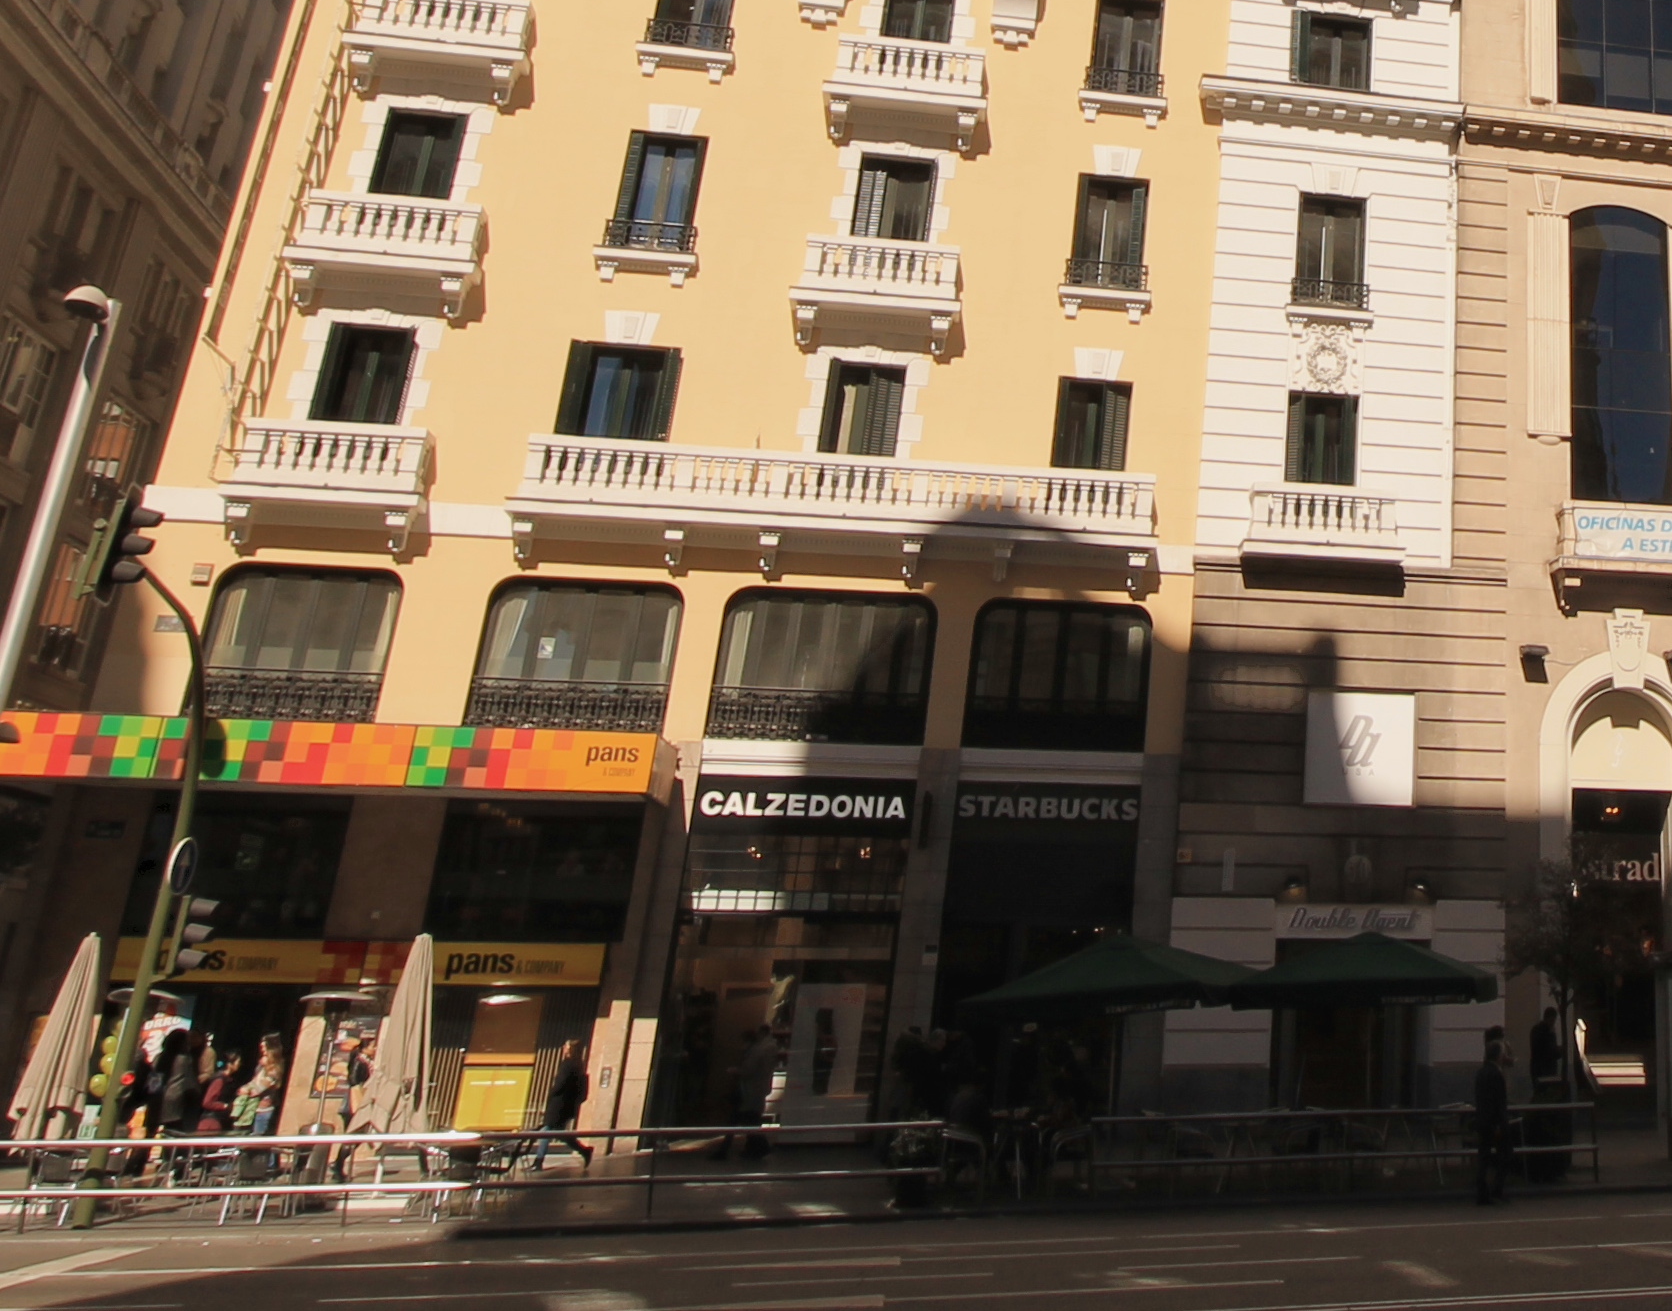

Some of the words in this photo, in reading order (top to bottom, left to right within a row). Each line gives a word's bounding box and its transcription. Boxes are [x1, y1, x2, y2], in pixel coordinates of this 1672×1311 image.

[1577, 515, 1656, 533] OFICINAS
[1621, 537, 1635, 551] A
[585, 745, 640, 767] pans
[700, 790, 906, 820] CALZEDONIA
[958, 794, 1139, 822] STARBUCKS
[1288, 906, 1356, 930] Double
[444, 952, 515, 981] pans
